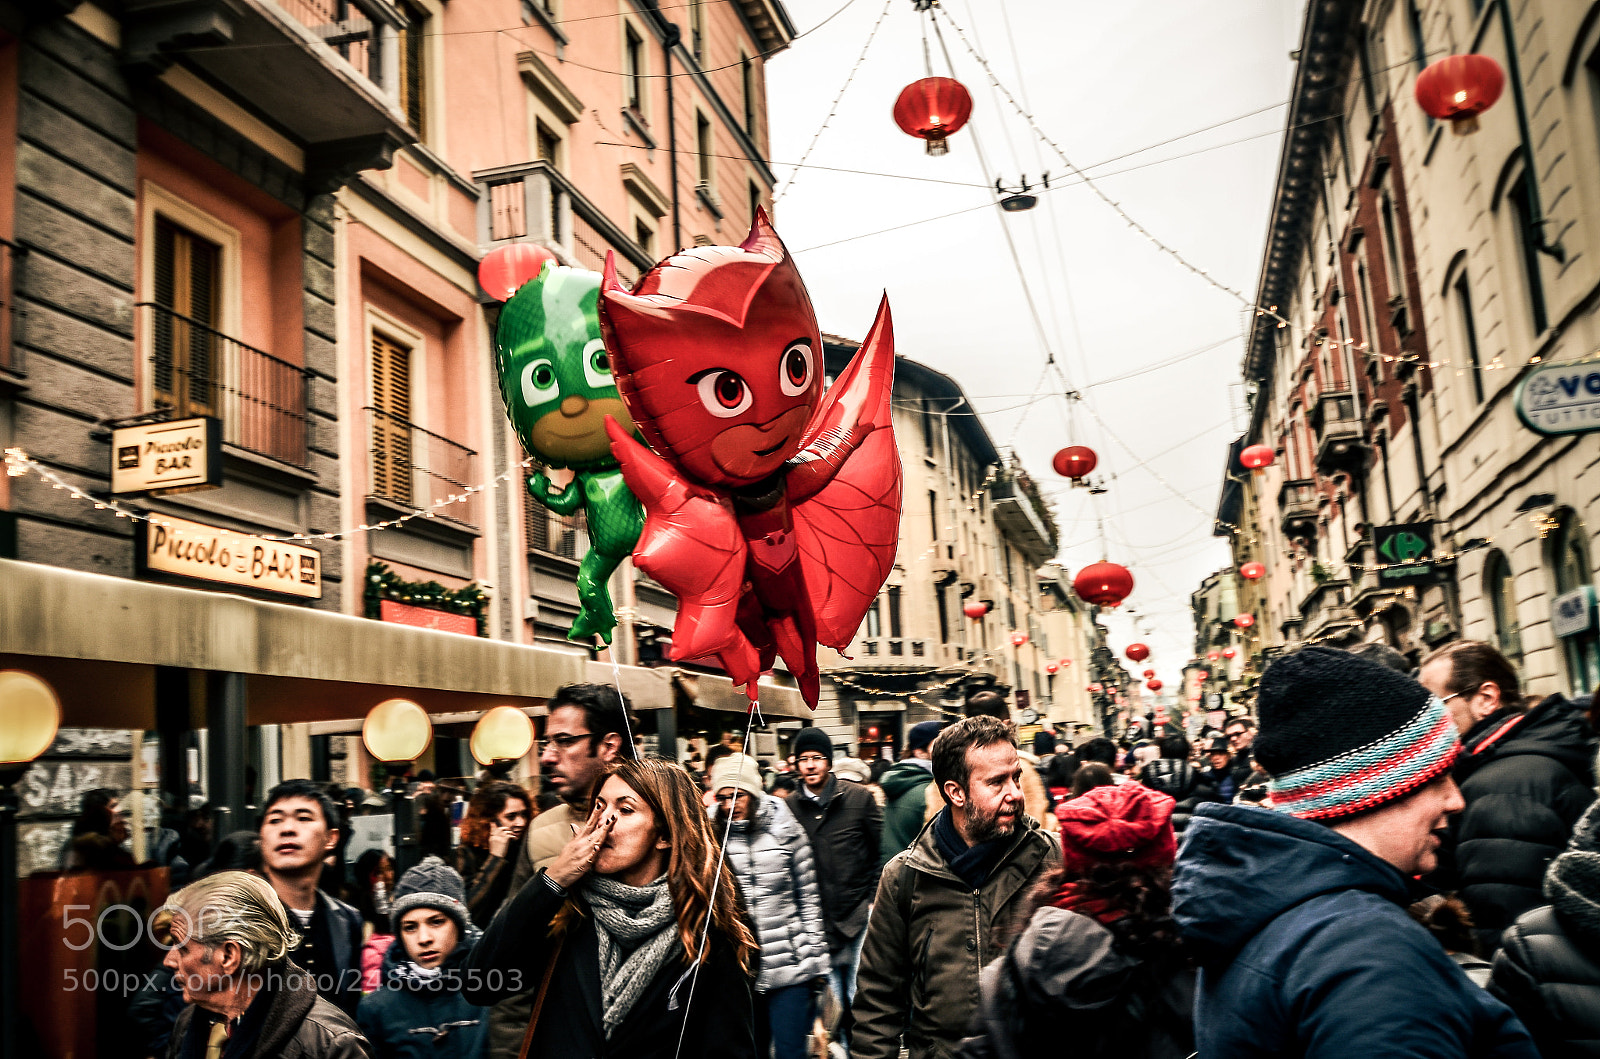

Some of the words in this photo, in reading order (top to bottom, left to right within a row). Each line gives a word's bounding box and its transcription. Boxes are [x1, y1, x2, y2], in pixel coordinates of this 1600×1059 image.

[144, 436, 202, 455] Piccolo
[154, 455, 192, 475] BAR
[150, 525, 231, 568] Piccolo
[251, 545, 294, 581] BAR
